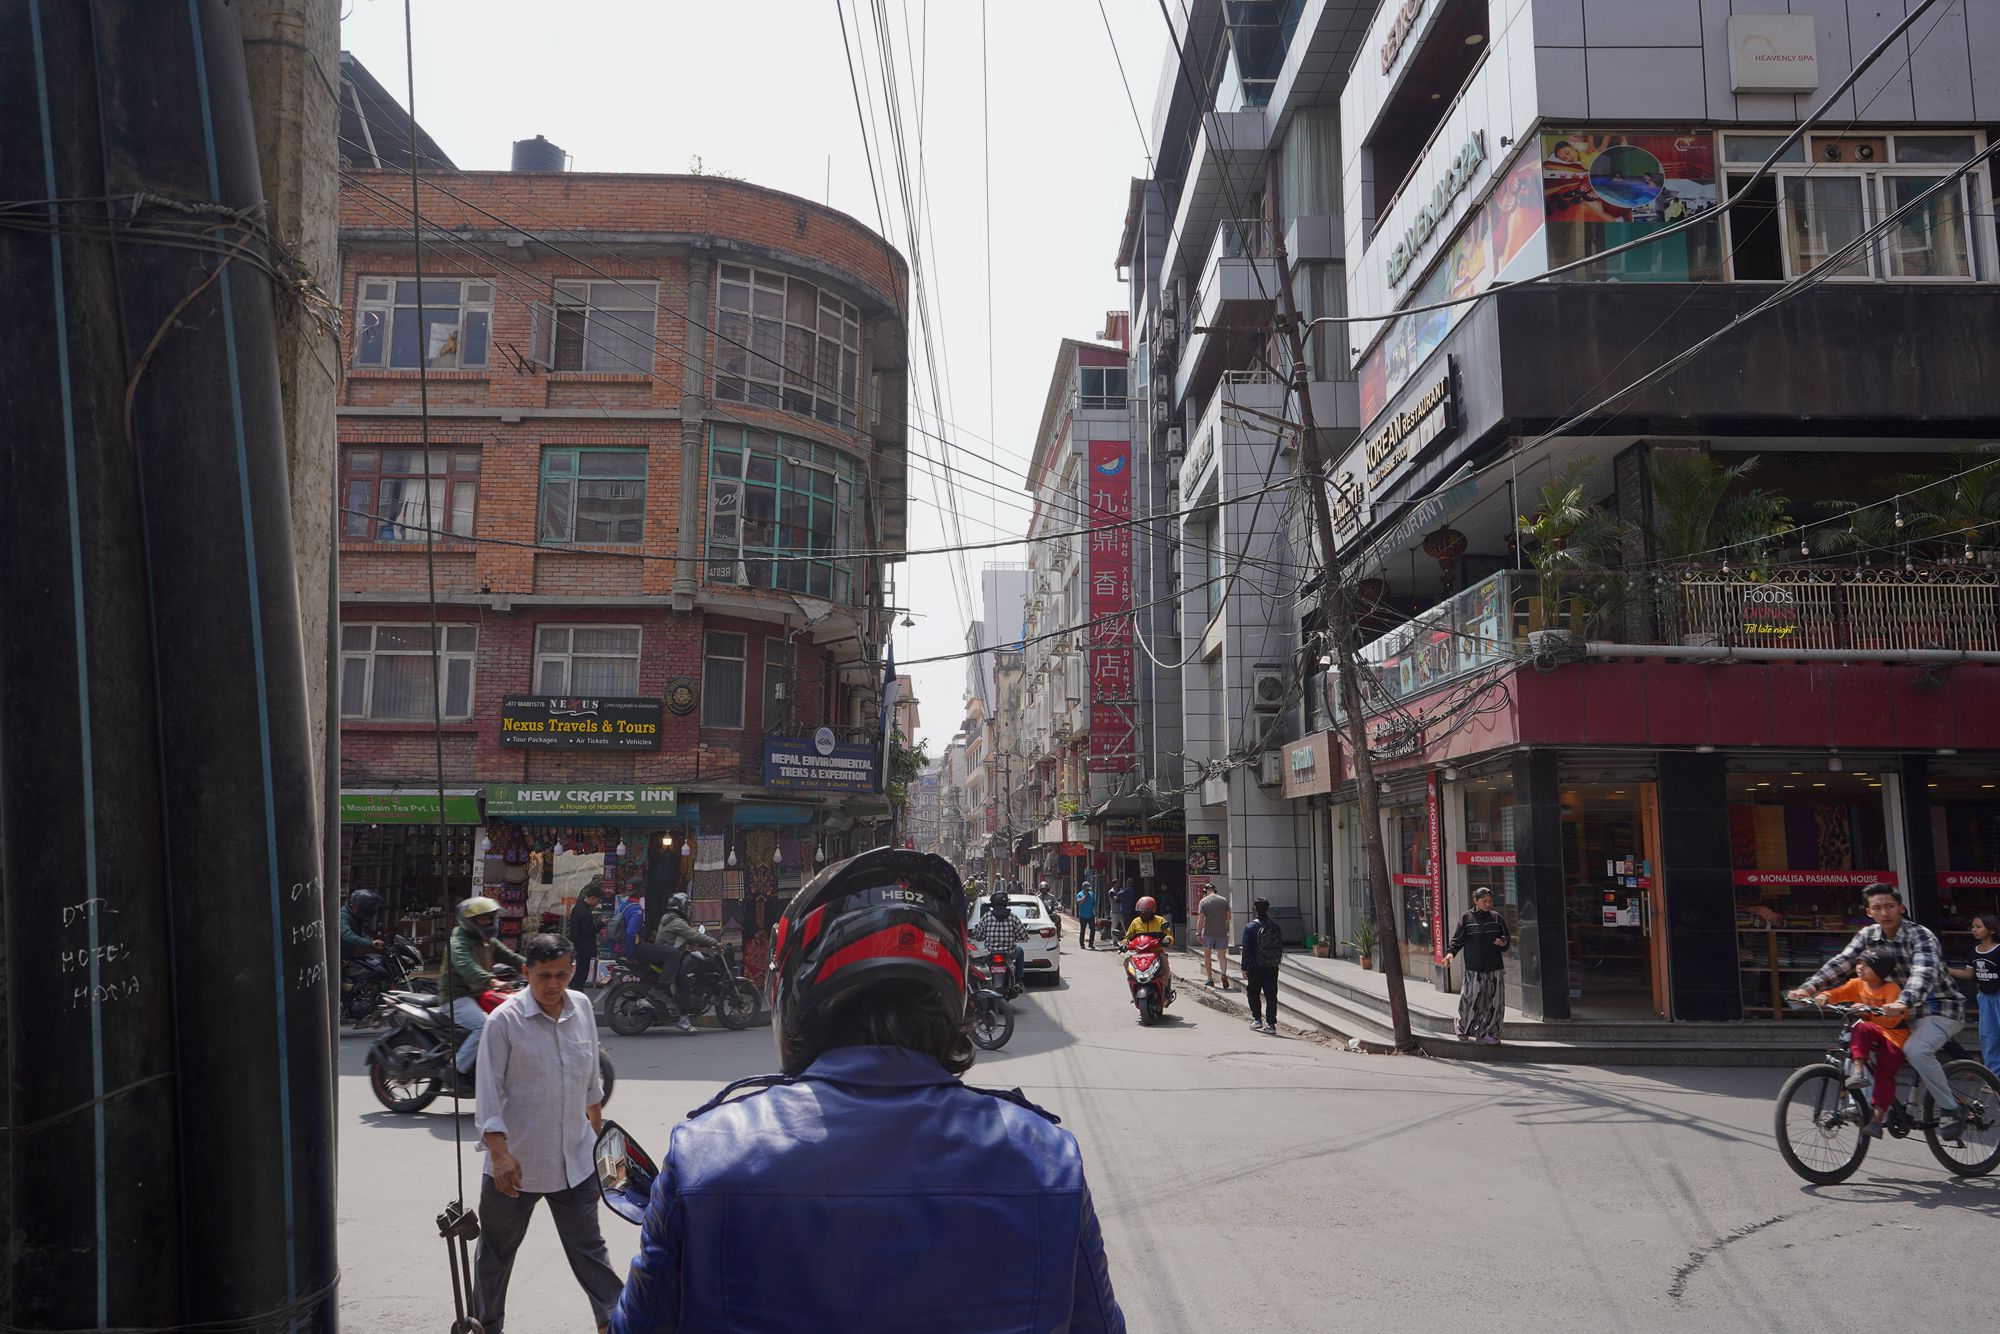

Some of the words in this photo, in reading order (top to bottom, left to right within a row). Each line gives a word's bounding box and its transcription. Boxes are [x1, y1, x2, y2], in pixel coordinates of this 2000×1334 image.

[1387, 169, 1452, 290] HEAVENLY
[1450, 131, 1487, 199] SPA
[1366, 414, 1404, 471] KOREAN
[1402, 377, 1447, 437] RESTAURANT
[1121, 566, 1130, 600] XIANG
[1744, 590, 1794, 604] FOODS
[1744, 624, 1757, 634] Till
[1758, 624, 1773, 633] late
[1773, 624, 1797, 638] night
[503, 718, 544, 731] Nexus
[548, 718, 598, 732] Travels
[602, 720, 613, 732] &
[617, 720, 656, 734] Tours
[771, 753, 800, 765] NEPAL
[802, 755, 873, 769] ENVIRONMENTAL
[779, 767, 809, 778] TREKS
[810, 769, 817, 779] &
[818, 769, 866, 780] EXPEDITION
[517, 790, 561, 801] NEW
[566, 790, 635, 803] CRAFTS
[641, 790, 674, 802] INN
[1760, 874, 1804, 883] MONALISA
[1806, 874, 1848, 883] PASHMINA
[1850, 875, 1878, 883] HOUSE
[1432, 862, 1440, 917] PASHMINA
[881, 890, 925, 904] HEDZ
[924, 940, 938, 951] DOT
